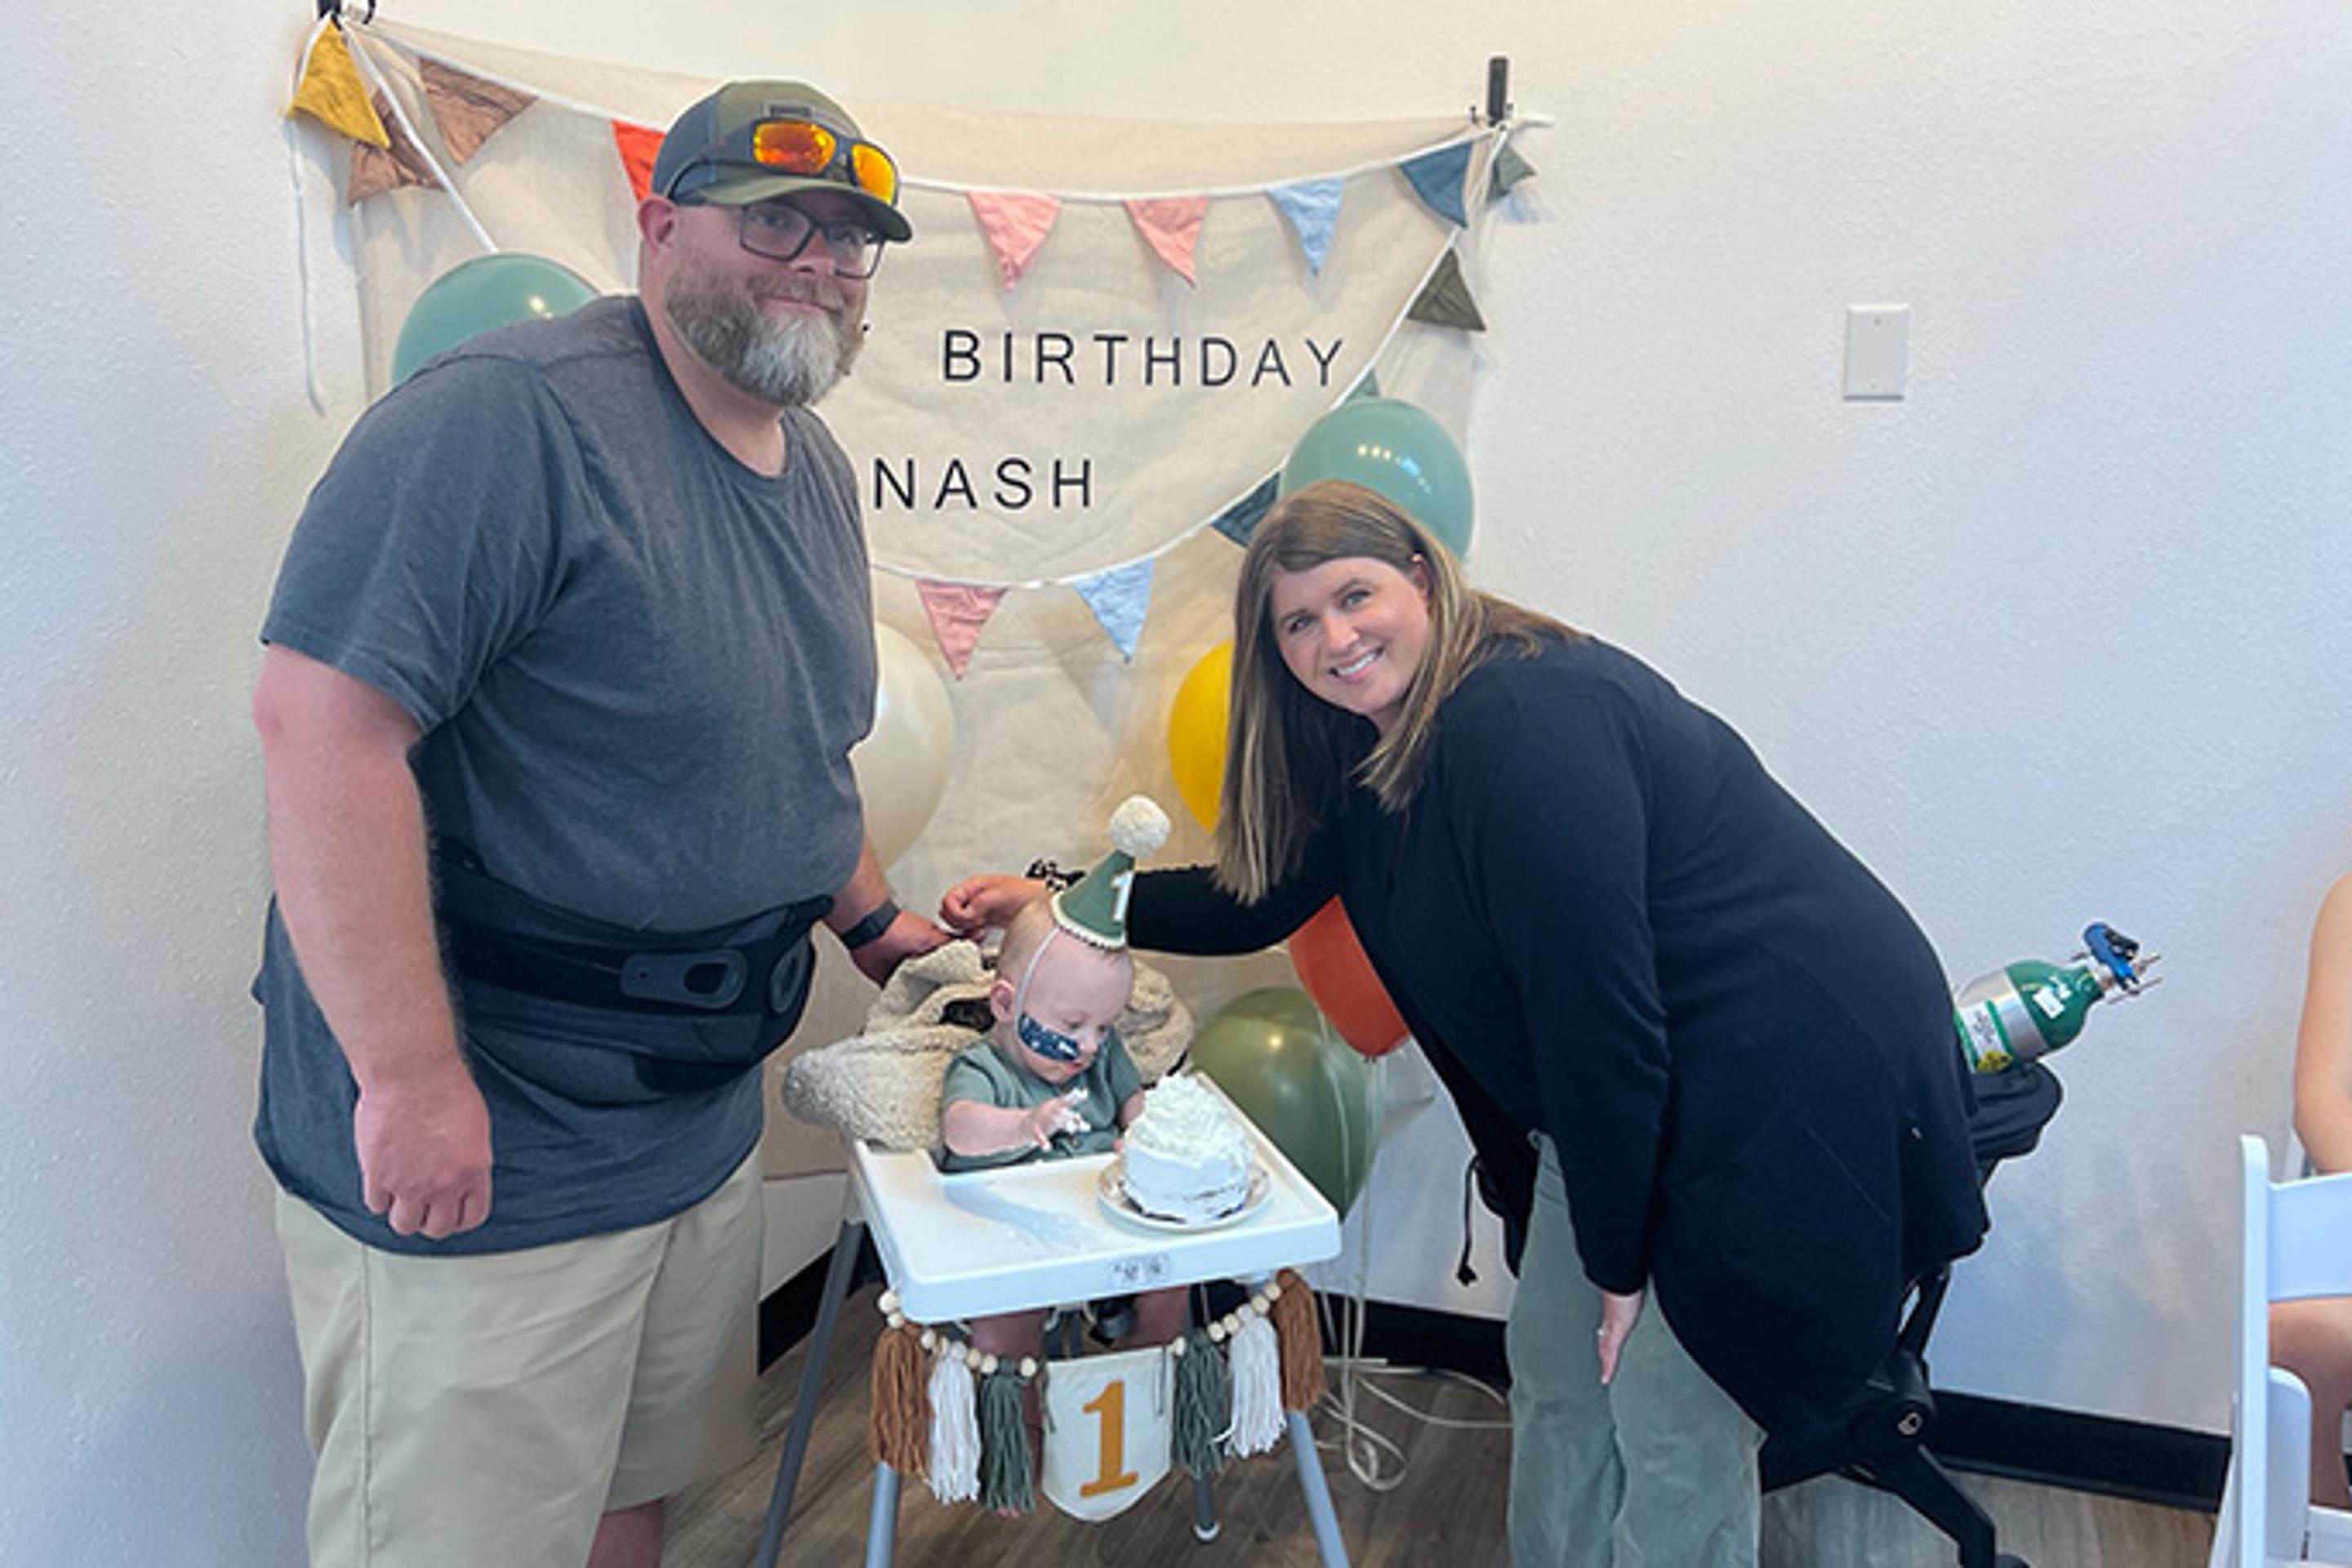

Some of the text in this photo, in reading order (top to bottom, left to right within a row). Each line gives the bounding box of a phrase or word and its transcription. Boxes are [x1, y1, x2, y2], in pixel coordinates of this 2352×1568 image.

[943, 330, 1343, 386] BIRTHDAY
[874, 457, 1091, 509] NASH
[1111, 871, 1133, 921] 1
[1079, 1379, 1138, 1497] 1
